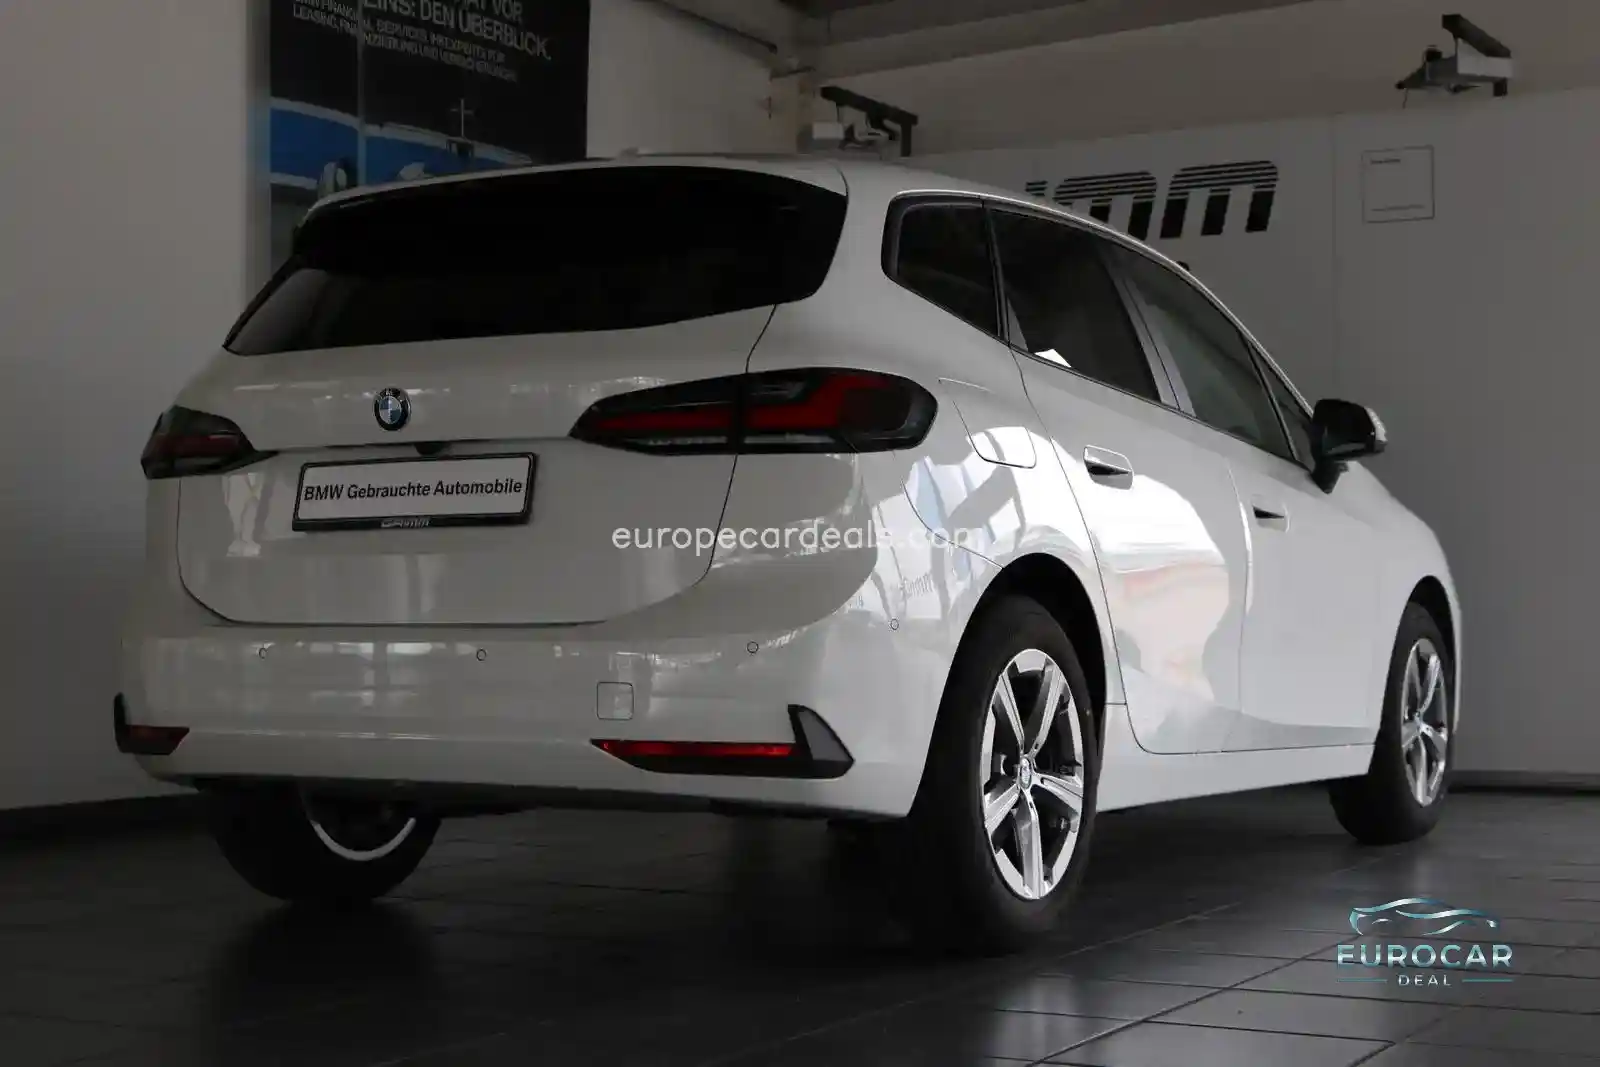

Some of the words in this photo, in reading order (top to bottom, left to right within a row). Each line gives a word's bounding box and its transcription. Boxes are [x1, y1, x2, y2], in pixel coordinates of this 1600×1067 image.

[420, 0, 455, 28] DEN
[303, 484, 344, 501] BMW
[347, 481, 430, 500] Gebrauchte
[433, 478, 523, 496] Automobile
